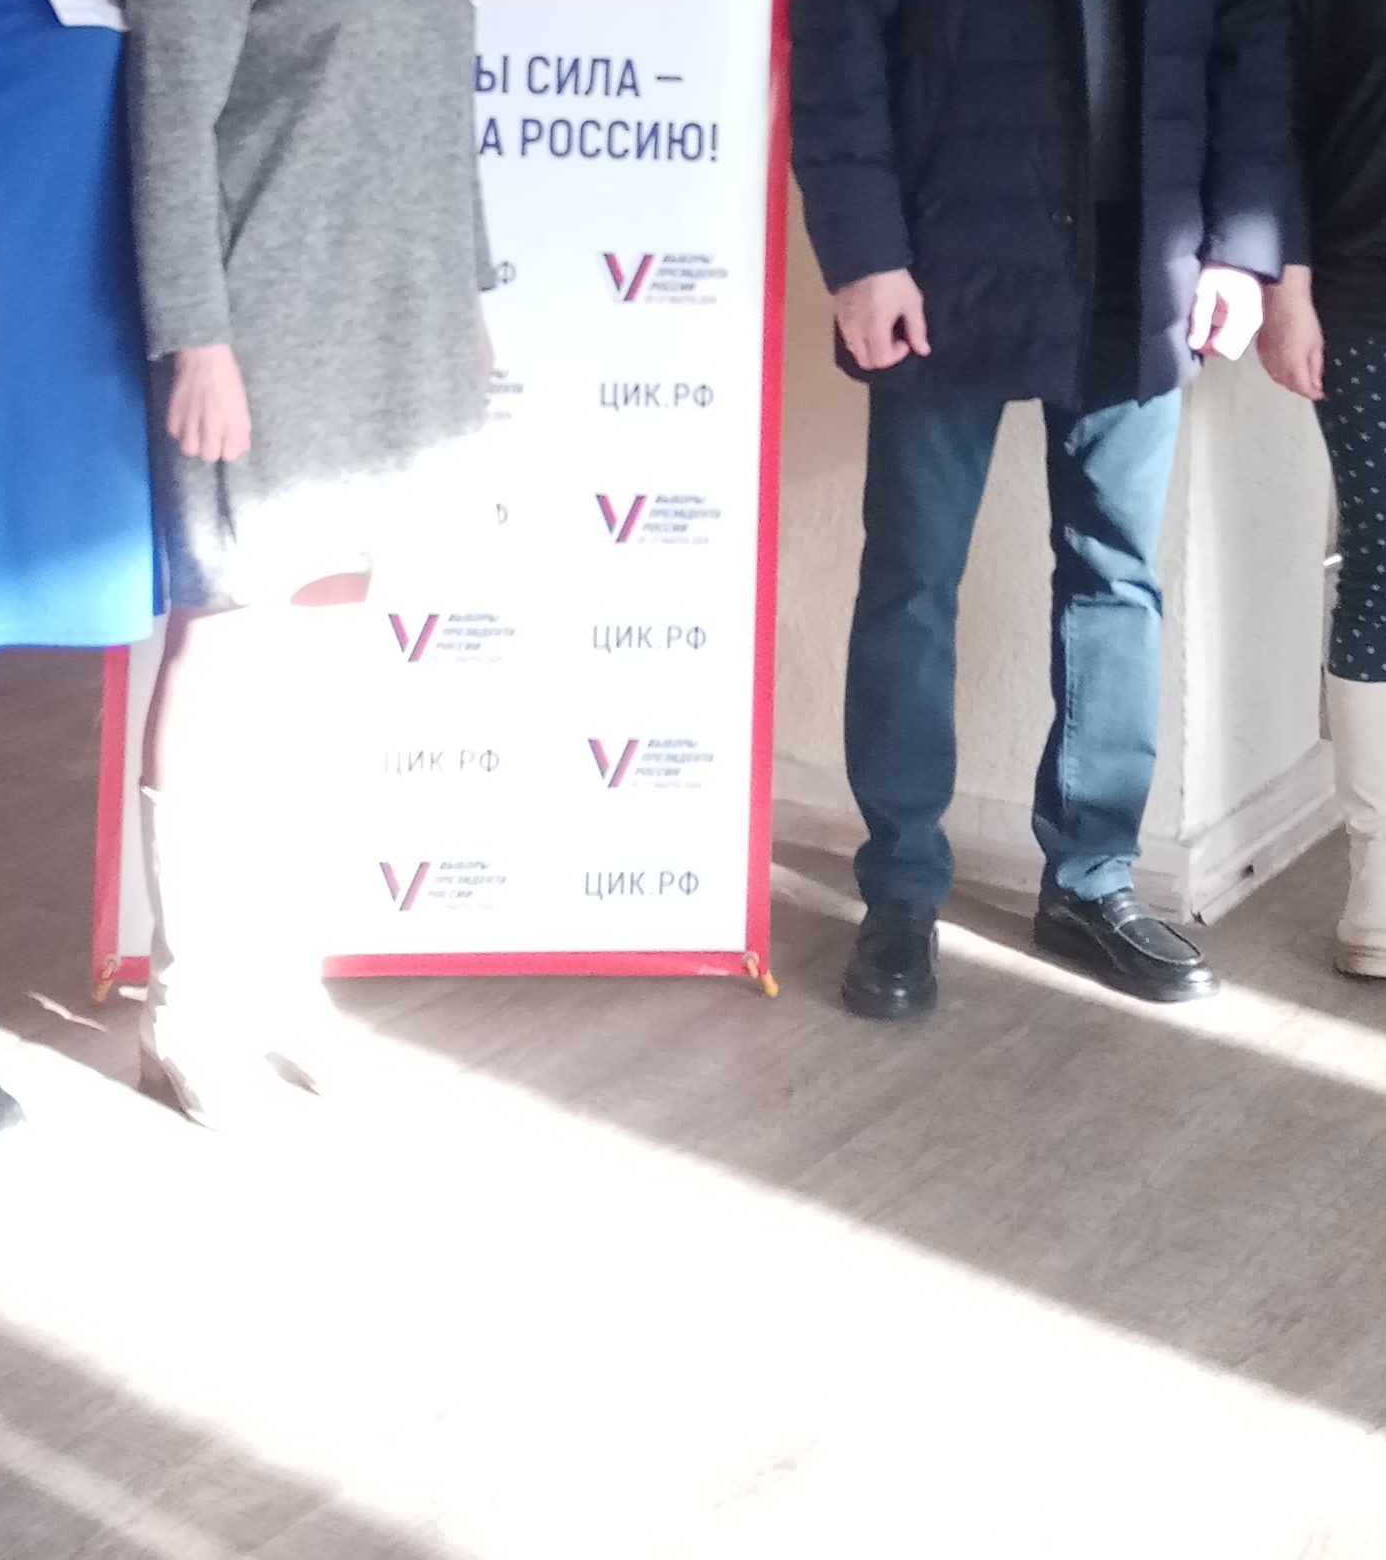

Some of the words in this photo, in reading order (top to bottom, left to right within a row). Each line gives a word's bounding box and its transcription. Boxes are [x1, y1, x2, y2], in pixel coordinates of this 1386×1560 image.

[474, 54, 509, 94] Ы
[527, 55, 641, 98] СИЛА
[479, 117, 504, 157] А
[521, 118, 718, 163] РОССИЮ!
[600, 381, 714, 413] ЦИК.РФ
[586, 870, 699, 900] ЦИК.РФ
